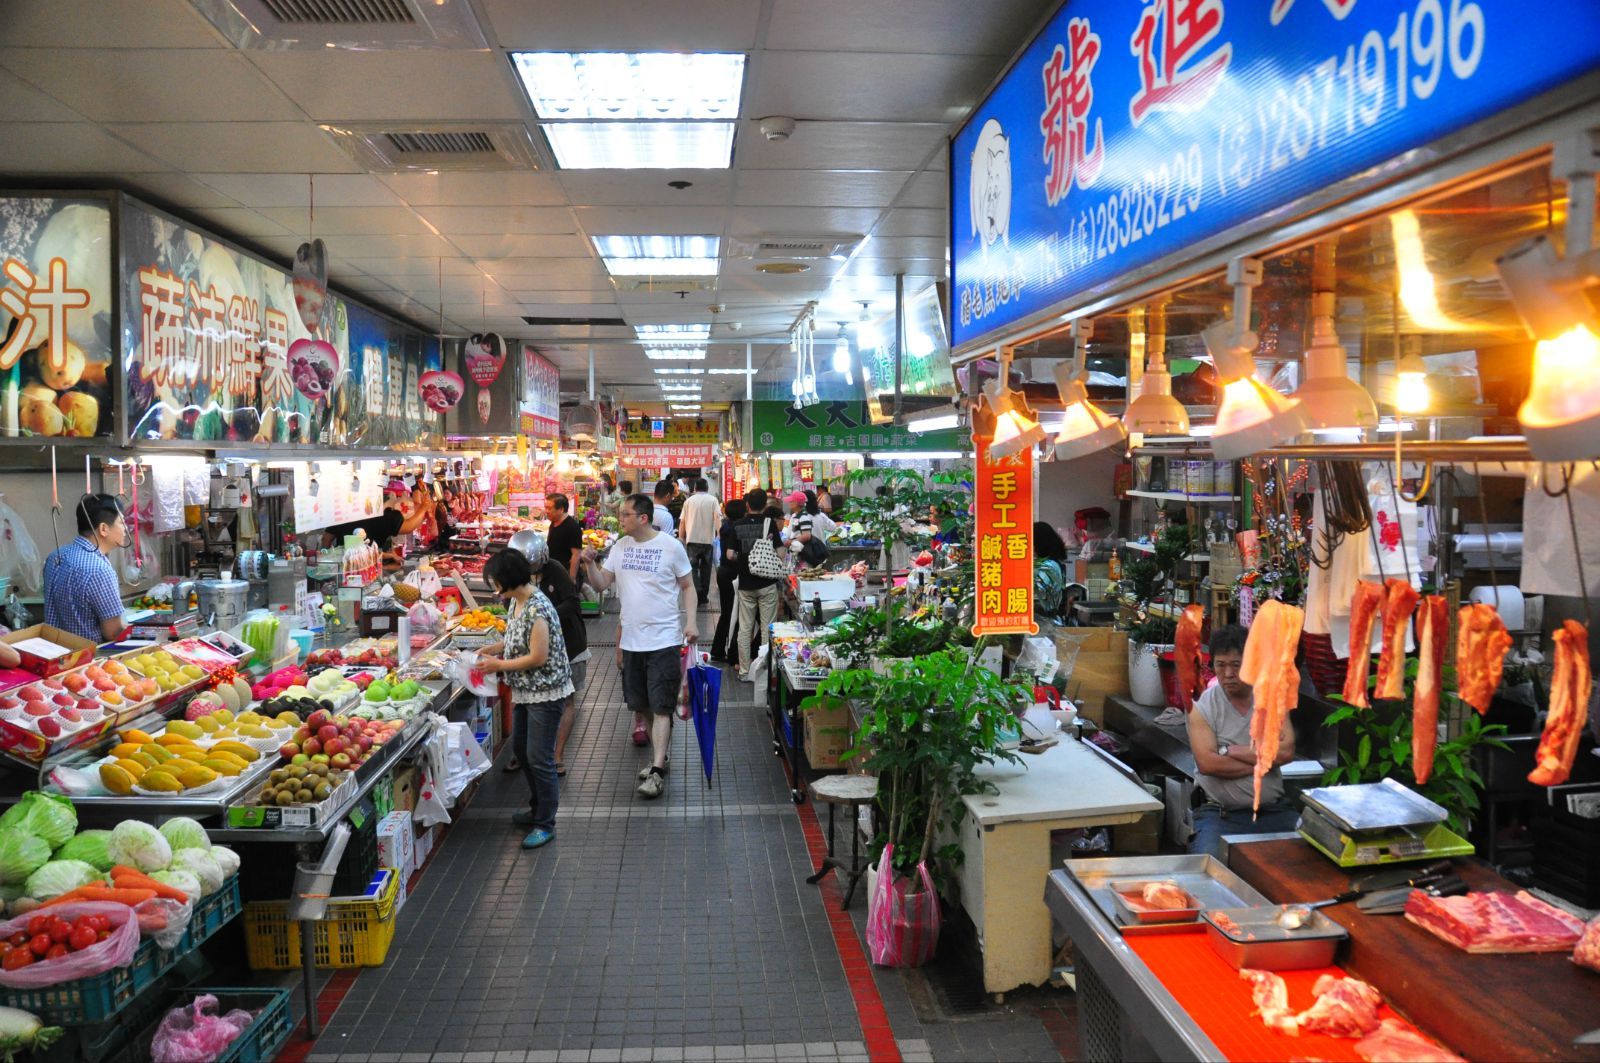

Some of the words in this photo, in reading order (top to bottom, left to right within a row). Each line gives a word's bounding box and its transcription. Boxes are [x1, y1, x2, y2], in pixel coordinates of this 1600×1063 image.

[0, 257, 91, 370] 汁
[991, 471, 1017, 528] 手工
[622, 563, 658, 572] MEMORABLE
[980, 534, 1003, 614] 鹹豬肉
[1006, 534, 1029, 614] 香腸
